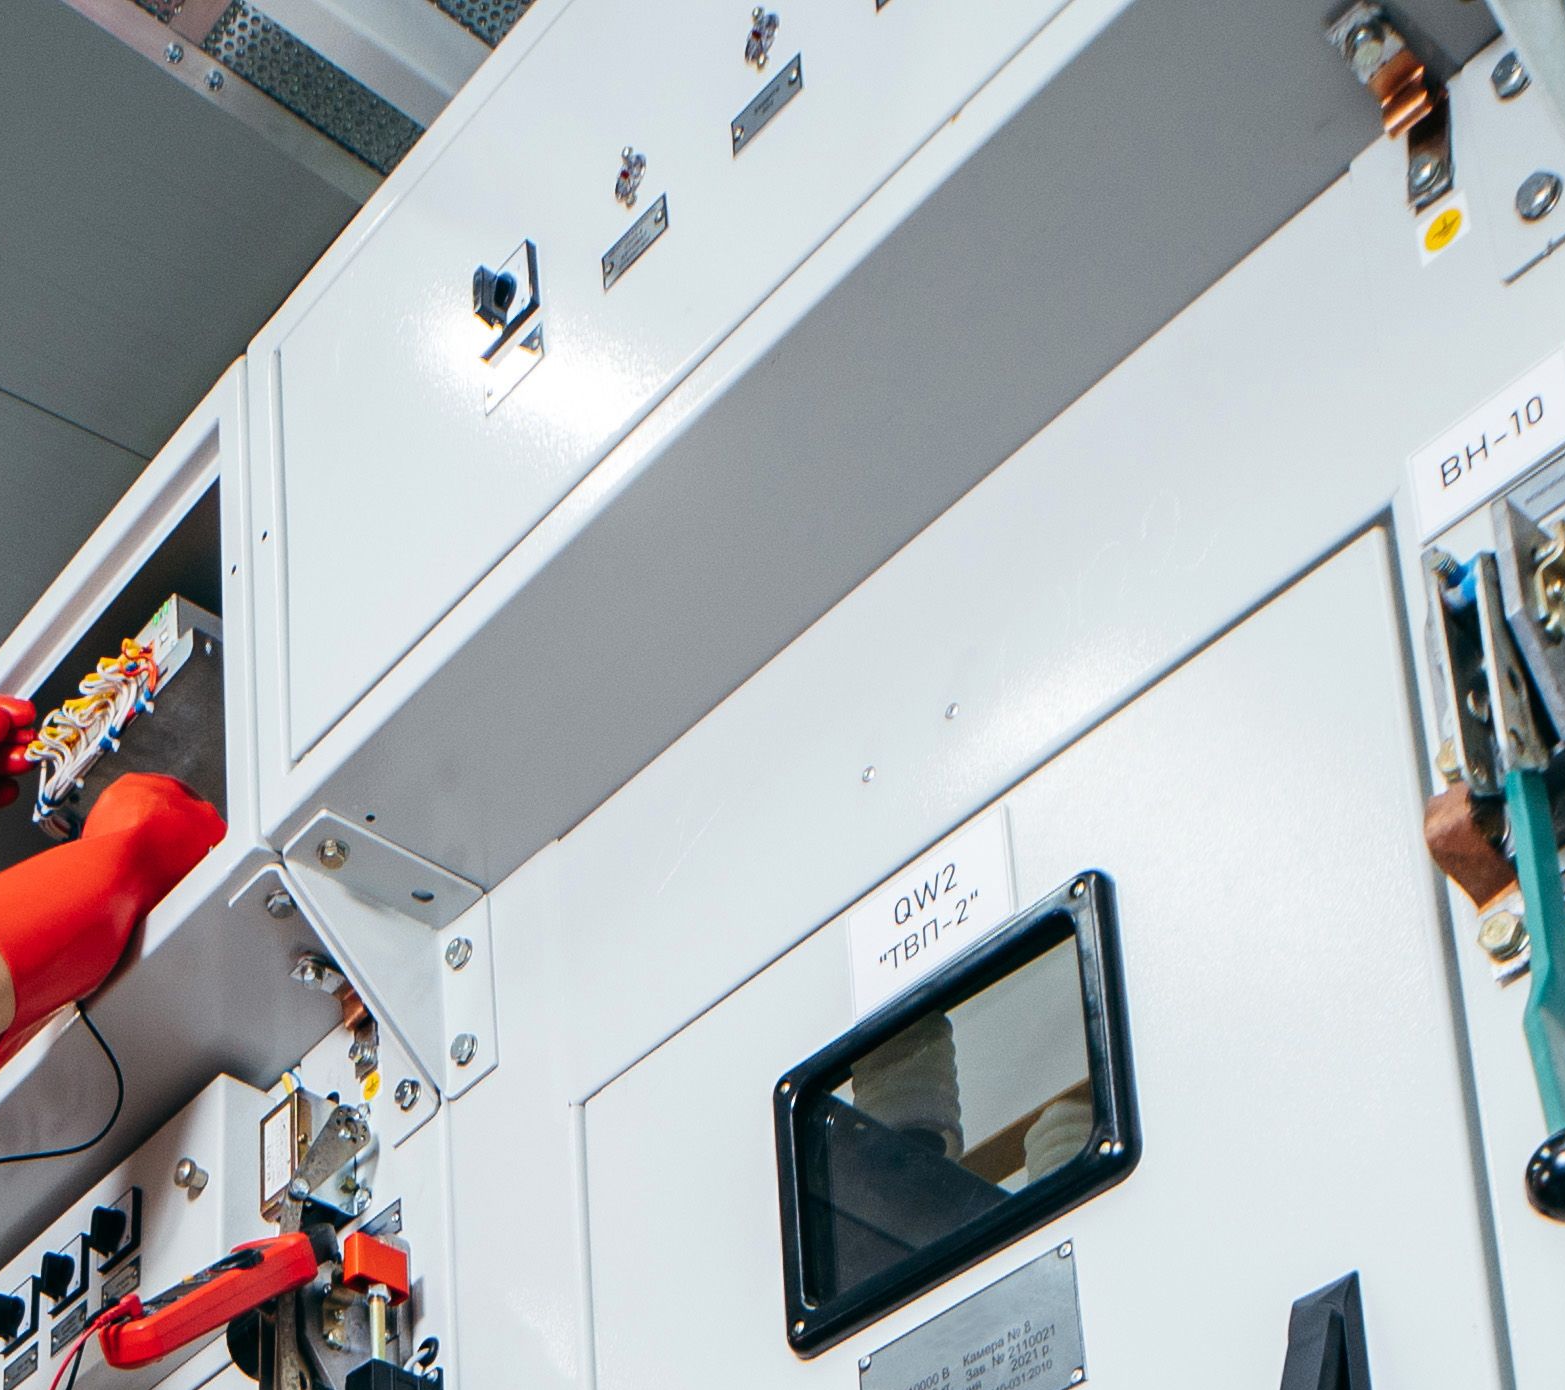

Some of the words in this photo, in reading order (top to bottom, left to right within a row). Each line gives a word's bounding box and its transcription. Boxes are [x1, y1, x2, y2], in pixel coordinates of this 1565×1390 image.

[1438, 395, 1545, 489] ВН-10
[893, 862, 958, 926] QW2
[962, 1337, 1005, 1368] Камера
[1007, 1323, 1056, 1360] 2110021
[1010, 1350, 1042, 1374] 2021
